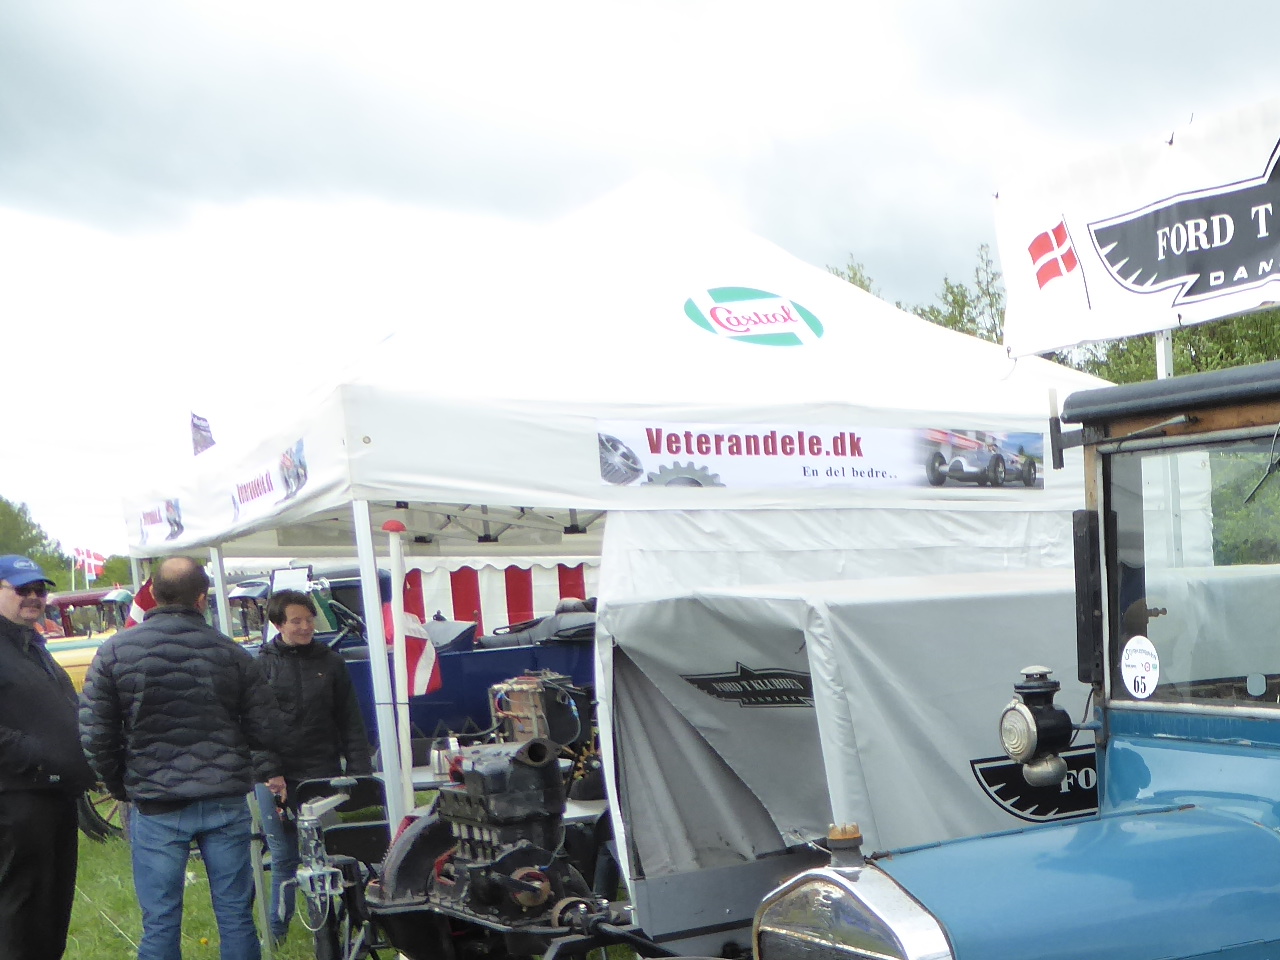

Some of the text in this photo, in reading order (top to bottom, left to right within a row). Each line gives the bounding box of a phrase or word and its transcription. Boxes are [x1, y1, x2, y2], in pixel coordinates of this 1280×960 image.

[1157, 213, 1235, 261] FORD
[1251, 203, 1272, 239] T
[709, 305, 799, 333] Castrol
[645, 427, 864, 458] Veterandele.dk
[802, 466, 819, 477] En
[826, 466, 846, 477] del
[1133, 675, 1146, 694] 65
